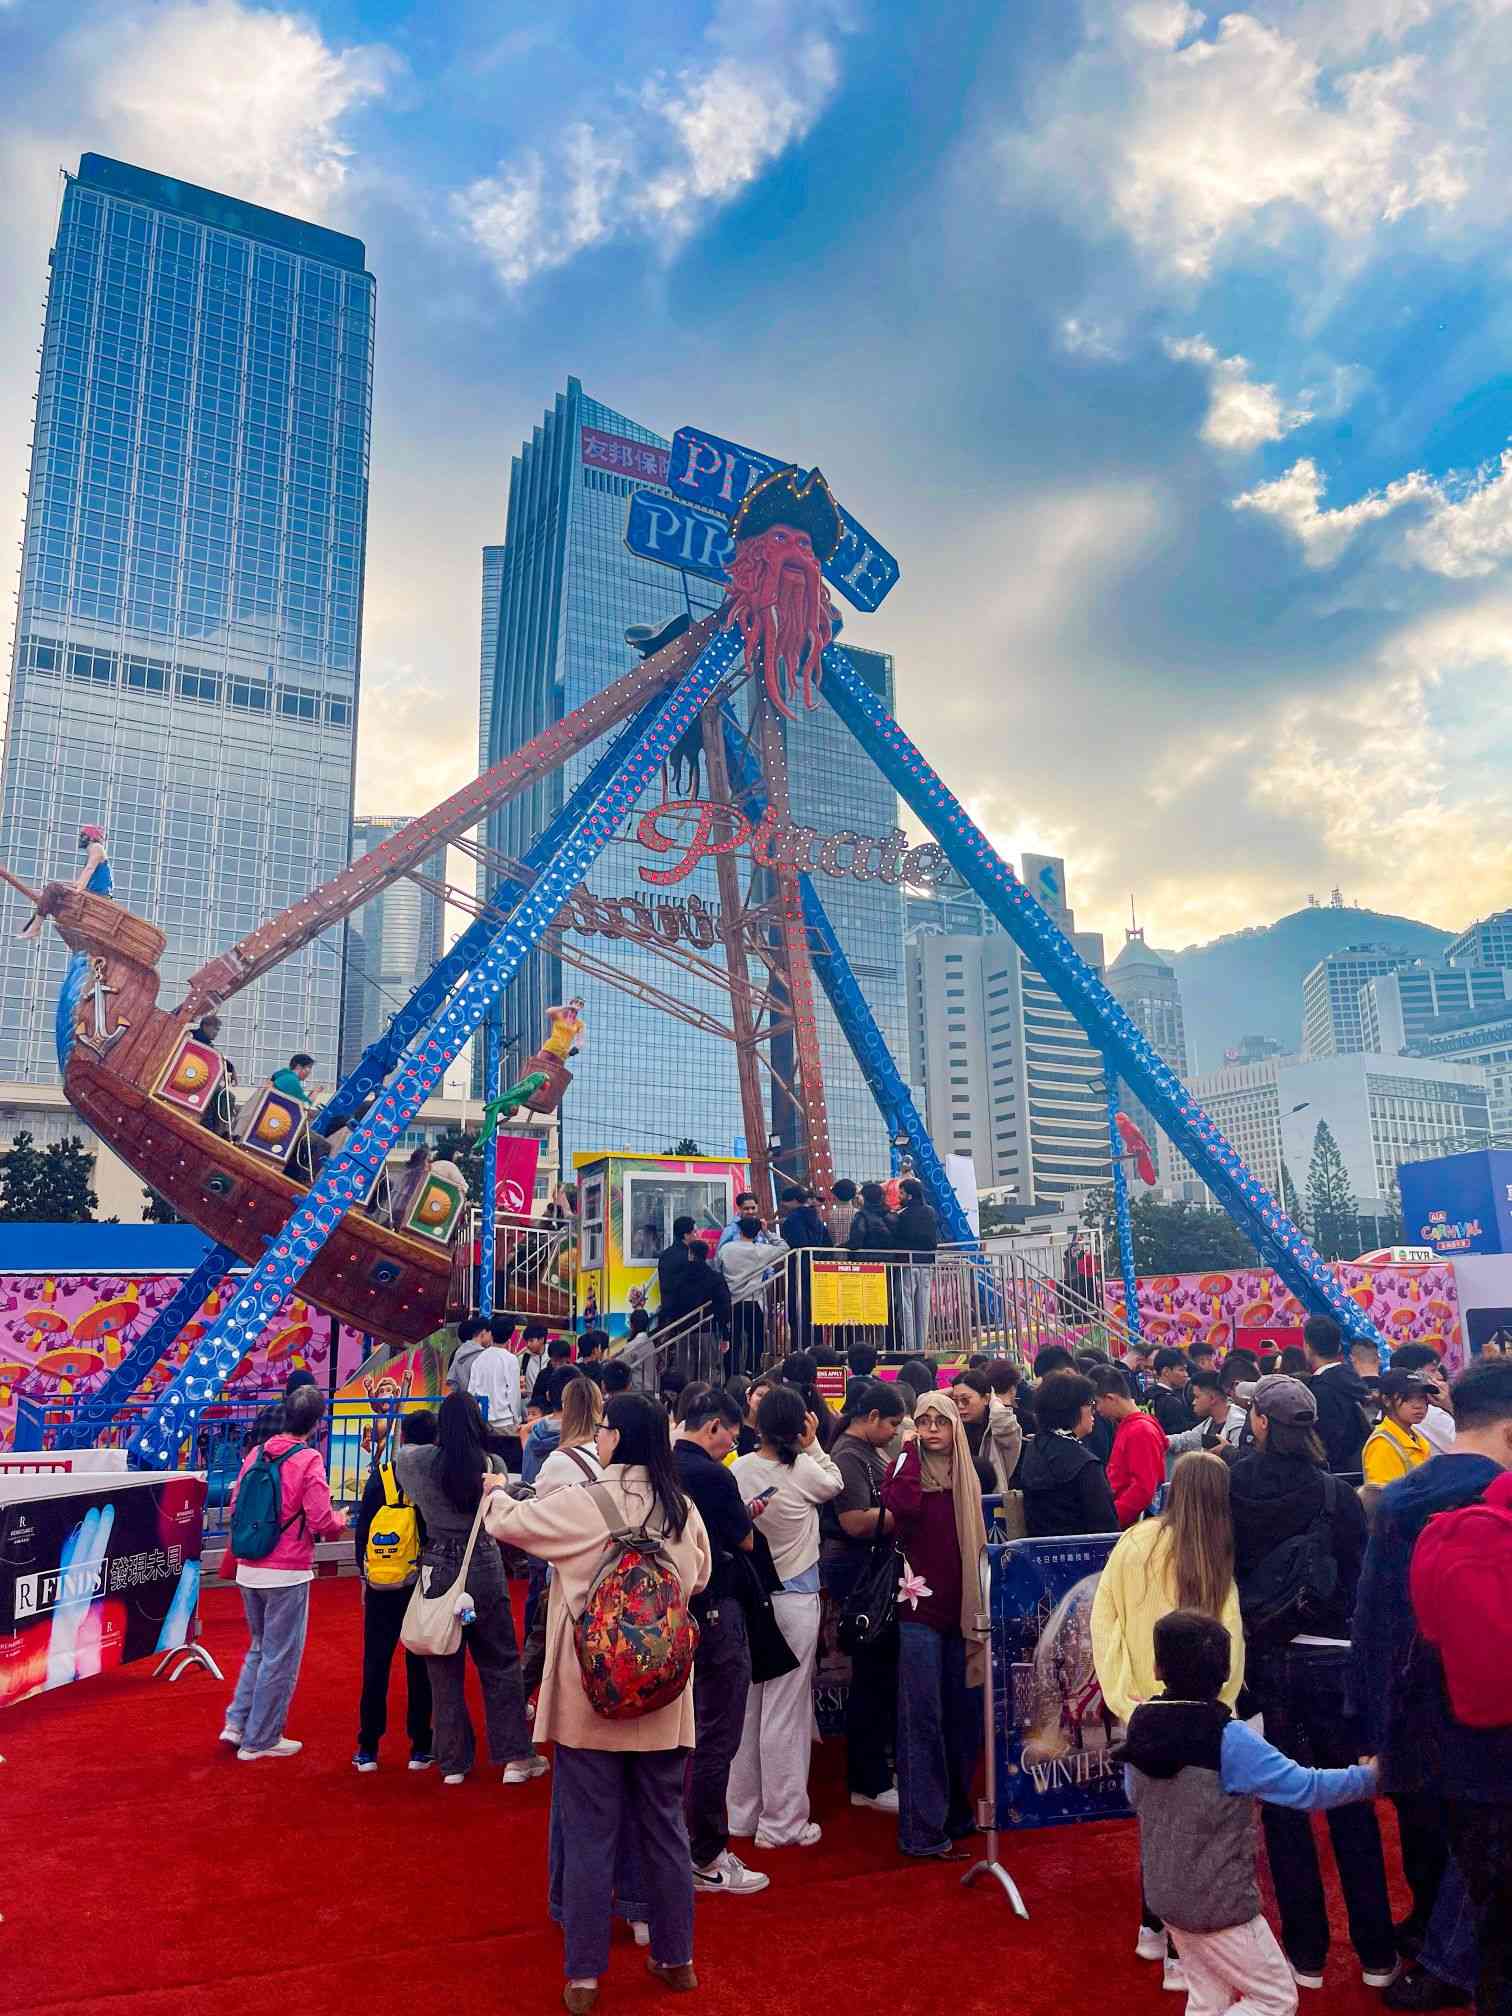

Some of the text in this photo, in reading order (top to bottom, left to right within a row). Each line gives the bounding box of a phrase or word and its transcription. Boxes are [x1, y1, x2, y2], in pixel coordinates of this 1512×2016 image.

[633, 492, 736, 570] PIR
[637, 799, 951, 887] Pirate
[19, 1566, 102, 1609] R FINDS
[110, 1544, 183, 1591] 發現未見
[1021, 1745, 1114, 1793] WINTER
